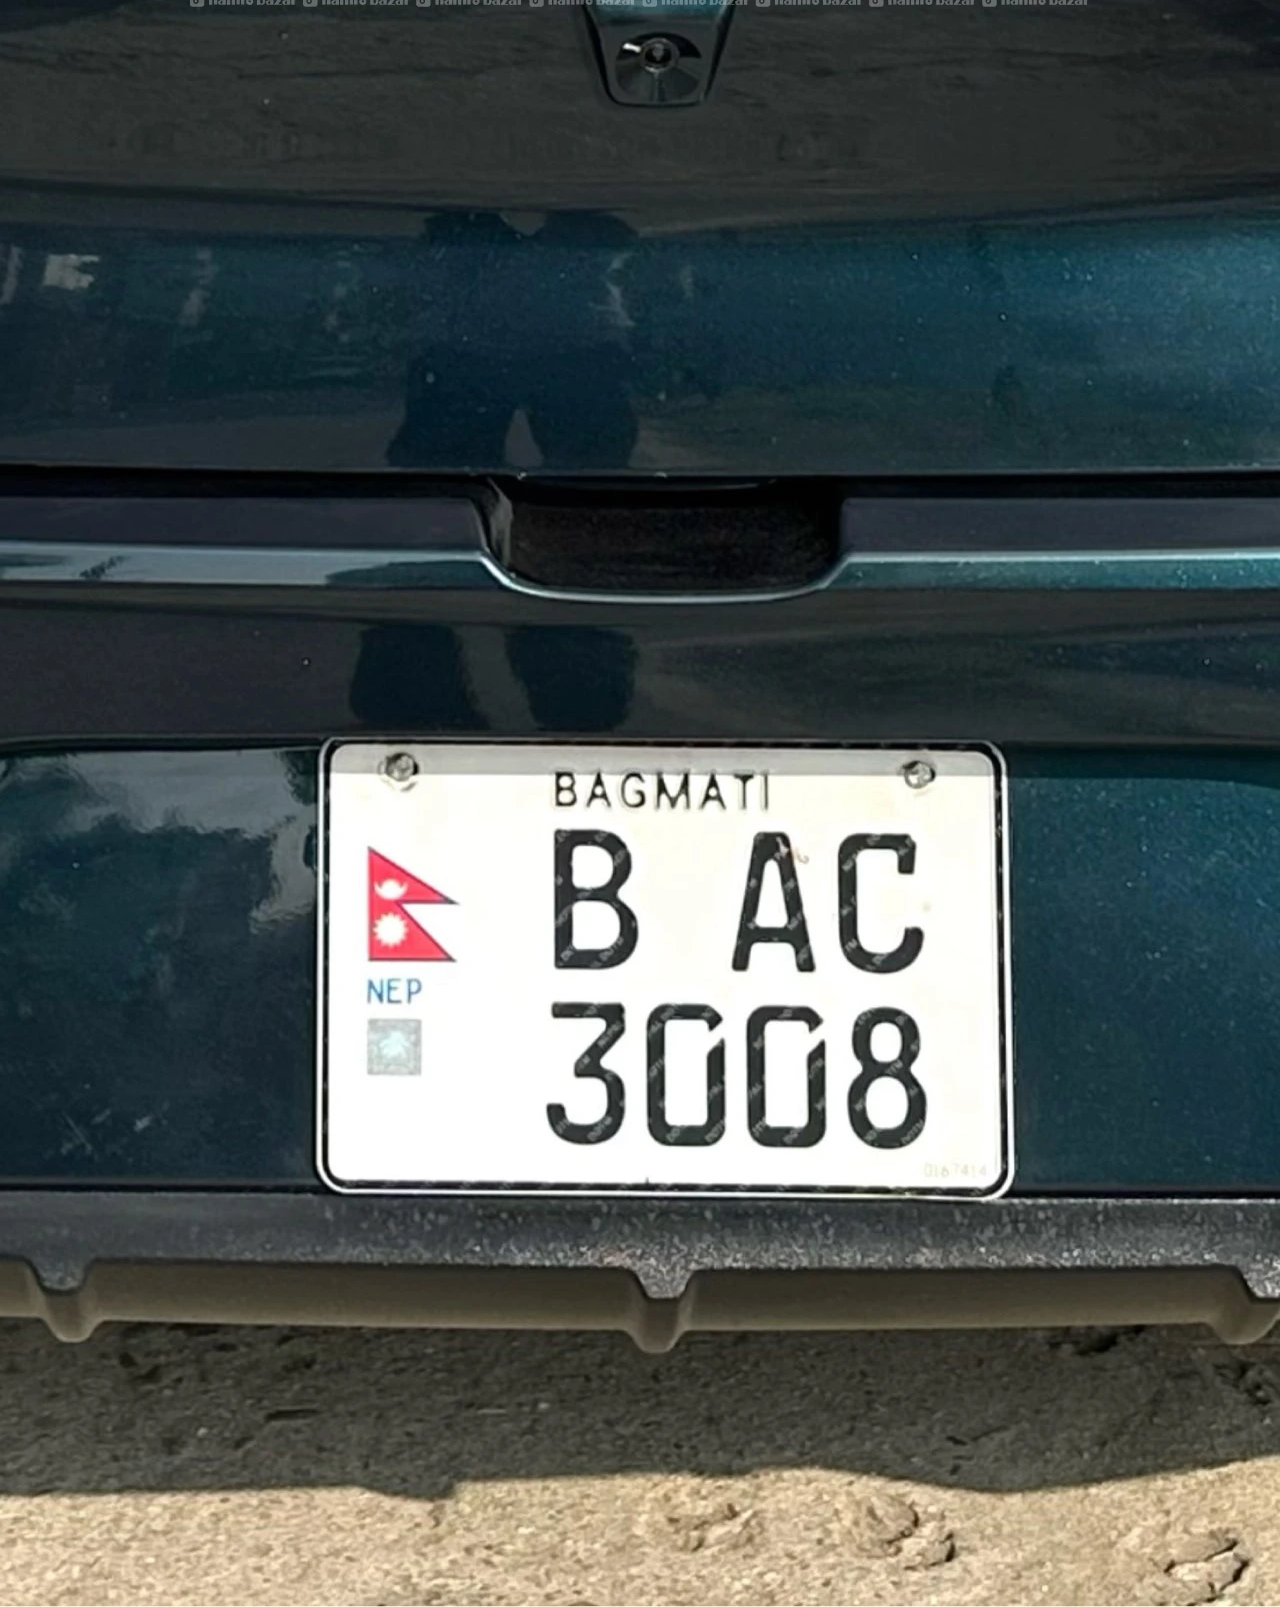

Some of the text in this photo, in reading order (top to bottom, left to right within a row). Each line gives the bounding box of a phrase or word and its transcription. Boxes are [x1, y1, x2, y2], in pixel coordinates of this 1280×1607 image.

[553, 771, 771, 812] BAGMATI
[553, 828, 926, 975] B AC
[366, 978, 423, 1005] NEP
[545, 1001, 928, 1151] 3008
